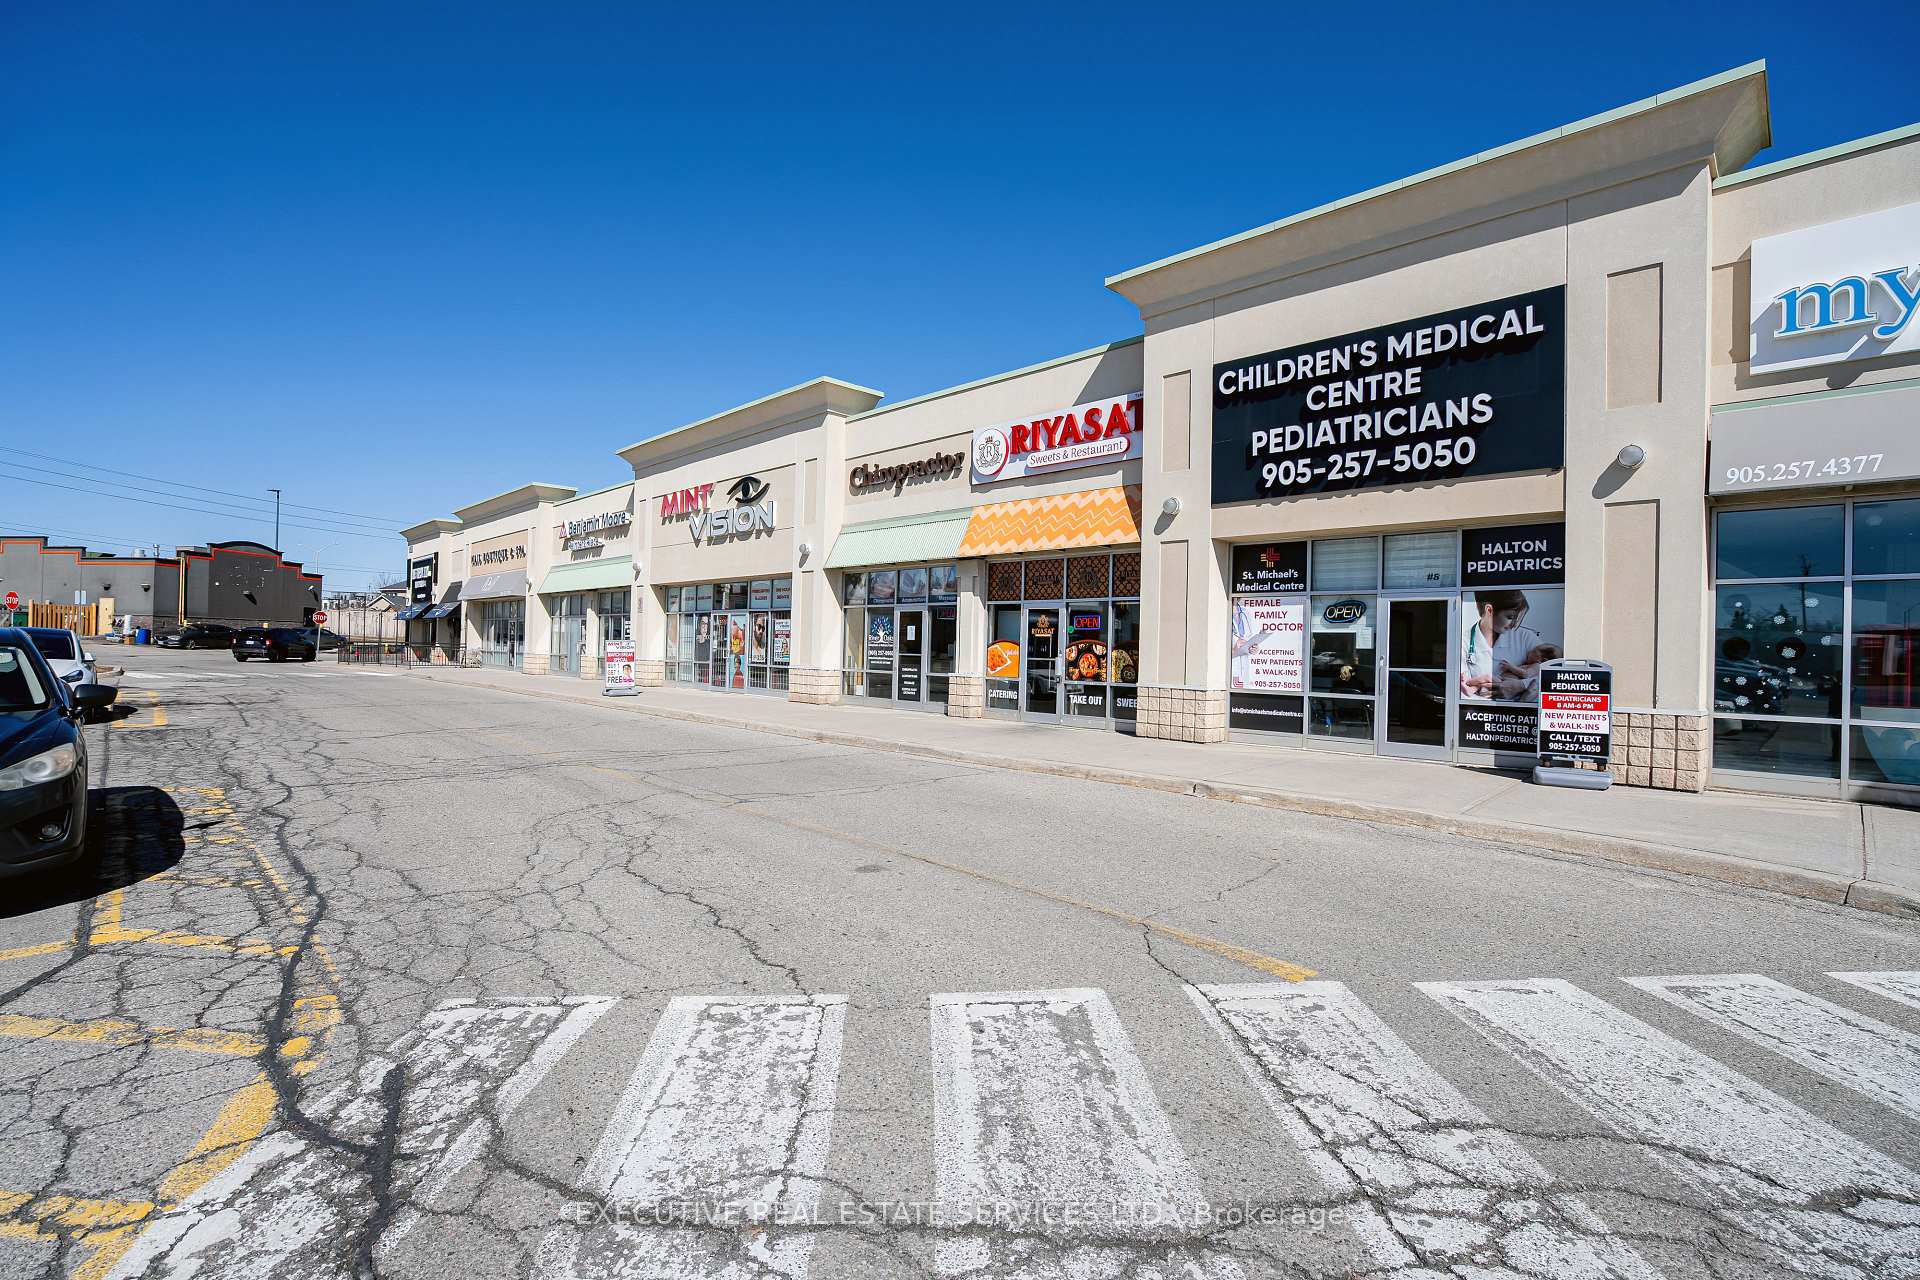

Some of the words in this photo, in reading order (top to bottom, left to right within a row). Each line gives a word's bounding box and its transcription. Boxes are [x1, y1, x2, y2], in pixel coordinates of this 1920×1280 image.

[1774, 265, 1920, 340] my
[1218, 340, 1378, 395] CHILDREN'S
[1387, 304, 1545, 362] MEDICAL
[1306, 366, 1422, 411] CENTRE
[1251, 393, 1494, 456] PEDIATRICIANS
[1029, 453, 1061, 466] Sweets
[1062, 450, 1069, 460] &
[1071, 441, 1124, 458] Restaurant
[1262, 436, 1477, 488] 905-257-5050
[850, 452, 966, 489] Chiropractor
[1726, 453, 1884, 485] 905.257.4377
[660, 482, 714, 518] MINT
[568, 515, 600, 536] Benjamin
[601, 512, 626, 527] Moore
[688, 501, 774, 541] VISION
[1481, 539, 1547, 556] HALTON
[1467, 557, 1563, 574] PEDIATRICS
[1242, 571, 1255, 580] St.
[1257, 569, 1299, 579] Michael's
[1236, 582, 1271, 591] Medical
[1273, 582, 1304, 591] Centre
[6, 597, 19, 605] STOP
[1244, 599, 1281, 607] FEMALE
[1254, 611, 1288, 619] FAMILY
[1326, 604, 1362, 619] OPEN
[1075, 618, 1099, 628] OPEN
[1262, 623, 1304, 631] DOCTOR
[1031, 627, 1055, 636] RIYASAT
[1557, 673, 1592, 681] HALTON
[1254, 681, 1301, 689] 905-257-5050
[1551, 682, 1600, 691] PEDIATRICS
[988, 689, 1018, 700] CATERING
[1069, 695, 1087, 705] TAKE
[1089, 696, 1103, 705] OUT
[1548, 695, 1602, 703] PEDIATRICIANS
[1465, 712, 1516, 723] ACCEPTING
[1566, 713, 1607, 721] PATIENTS
[1484, 723, 1529, 734] REGISTER
[1557, 722, 1600, 731] WALK-INS
[1549, 734, 1572, 742] CALL
[1578, 735, 1602, 743] TEXT
[1548, 743, 1601, 753] 905-257-5050
